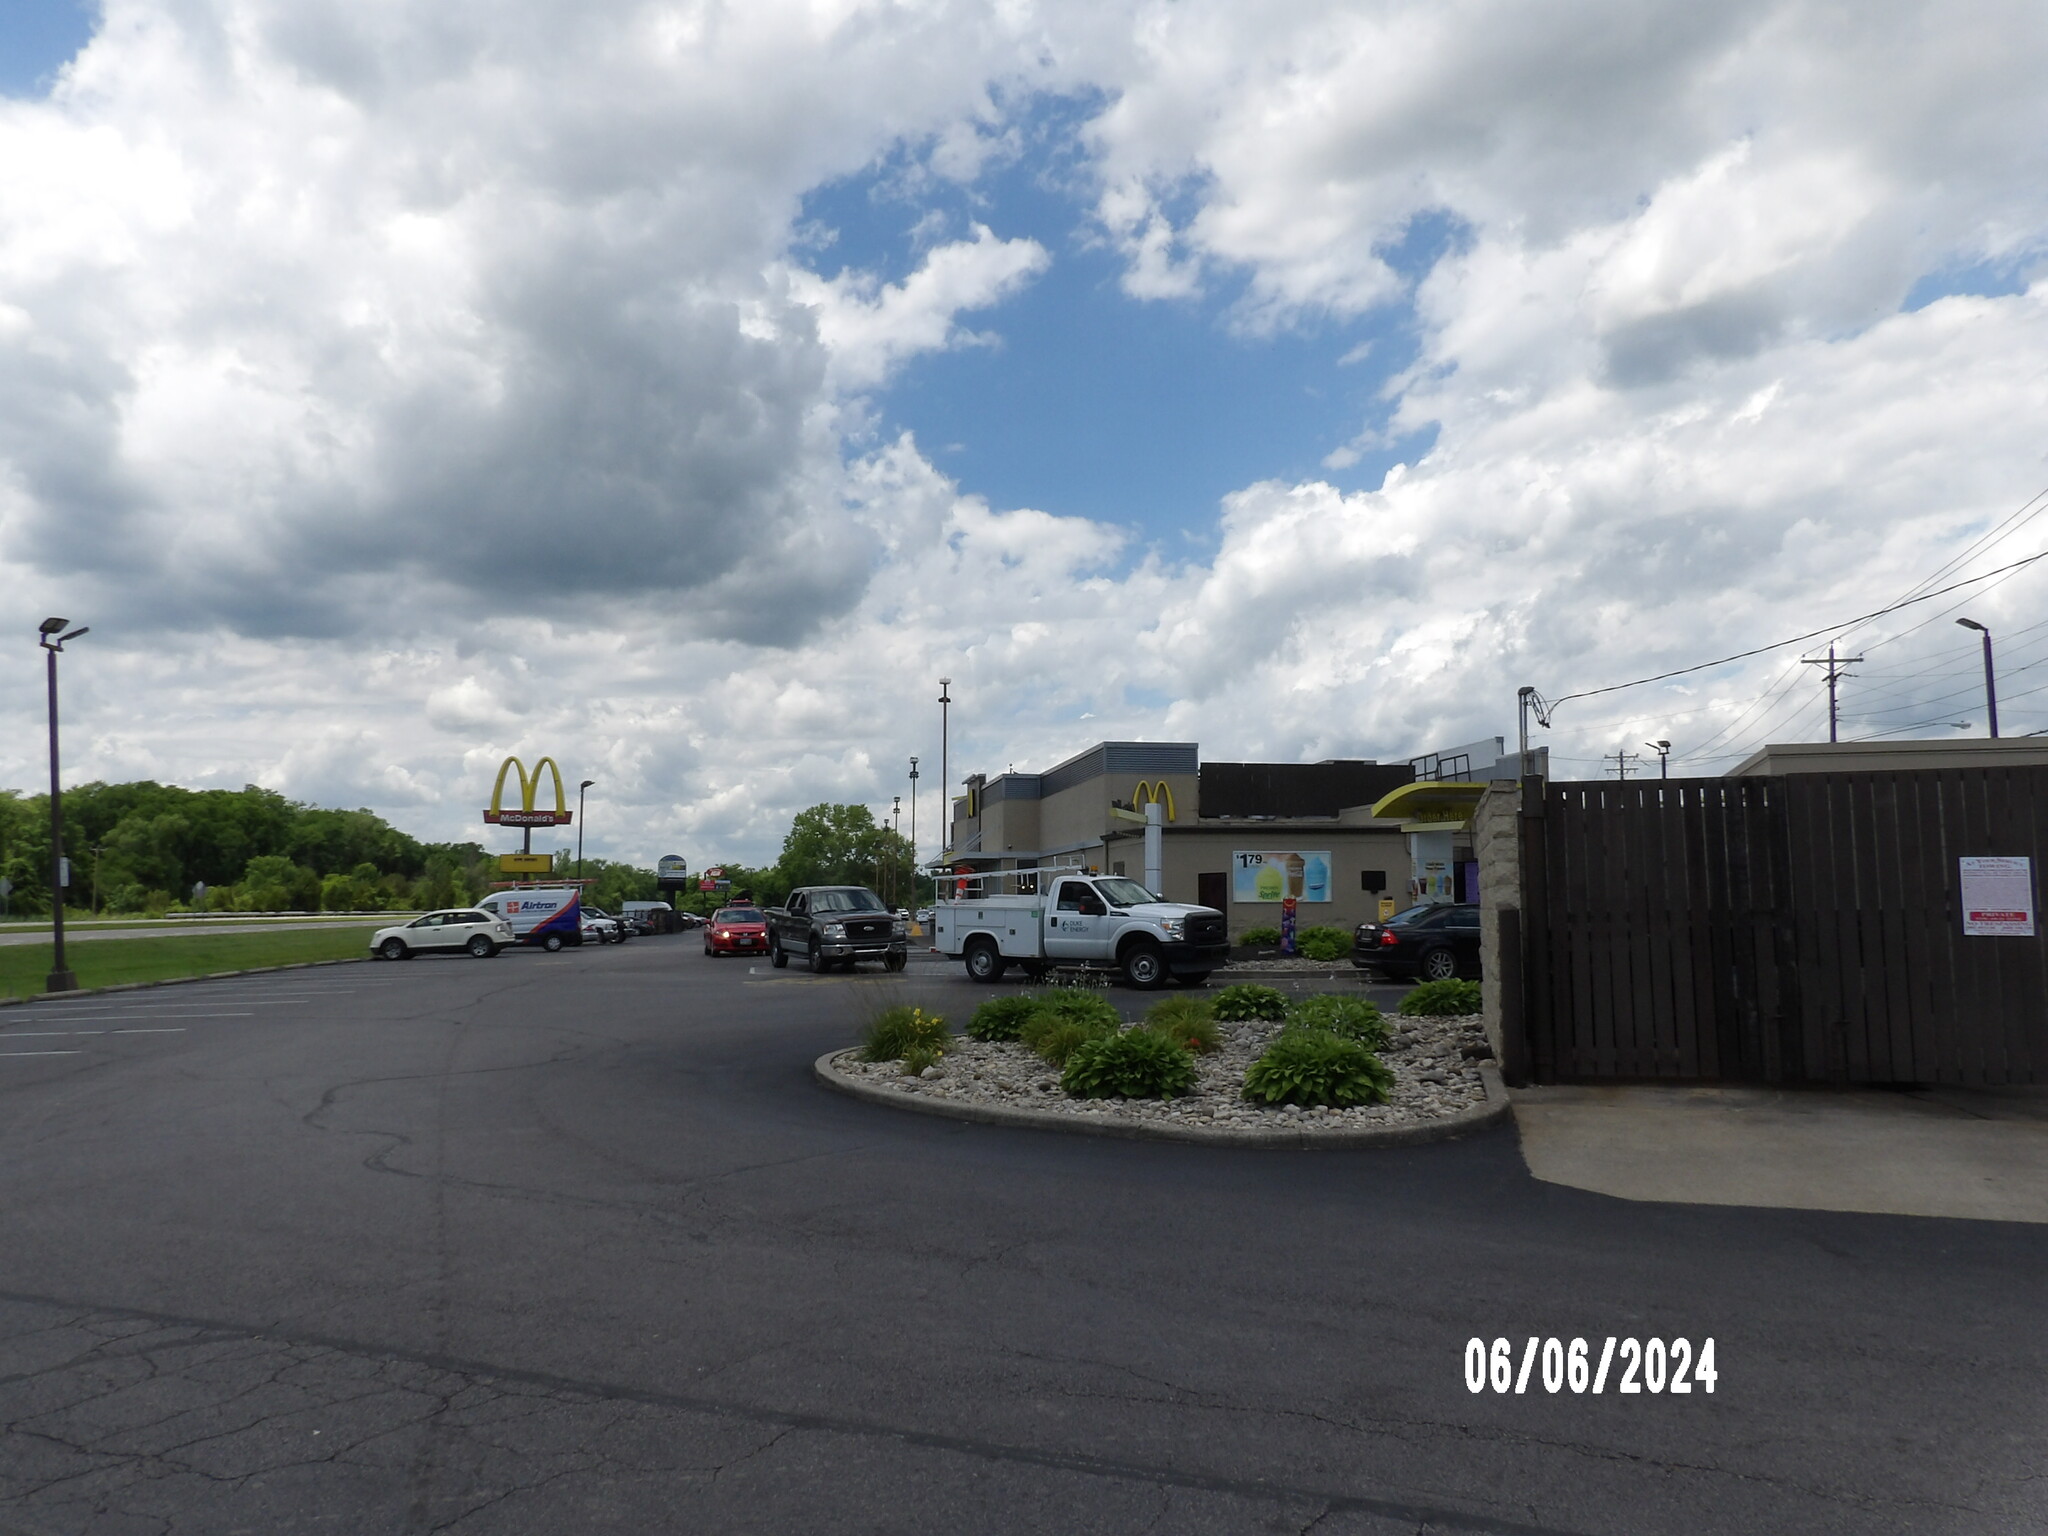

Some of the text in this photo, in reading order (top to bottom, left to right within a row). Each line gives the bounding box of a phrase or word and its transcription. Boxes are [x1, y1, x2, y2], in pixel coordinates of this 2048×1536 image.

[500, 814, 554, 822] McDonald's
[1259, 890, 1281, 899] Sprite
[521, 901, 557, 910] Airtron
